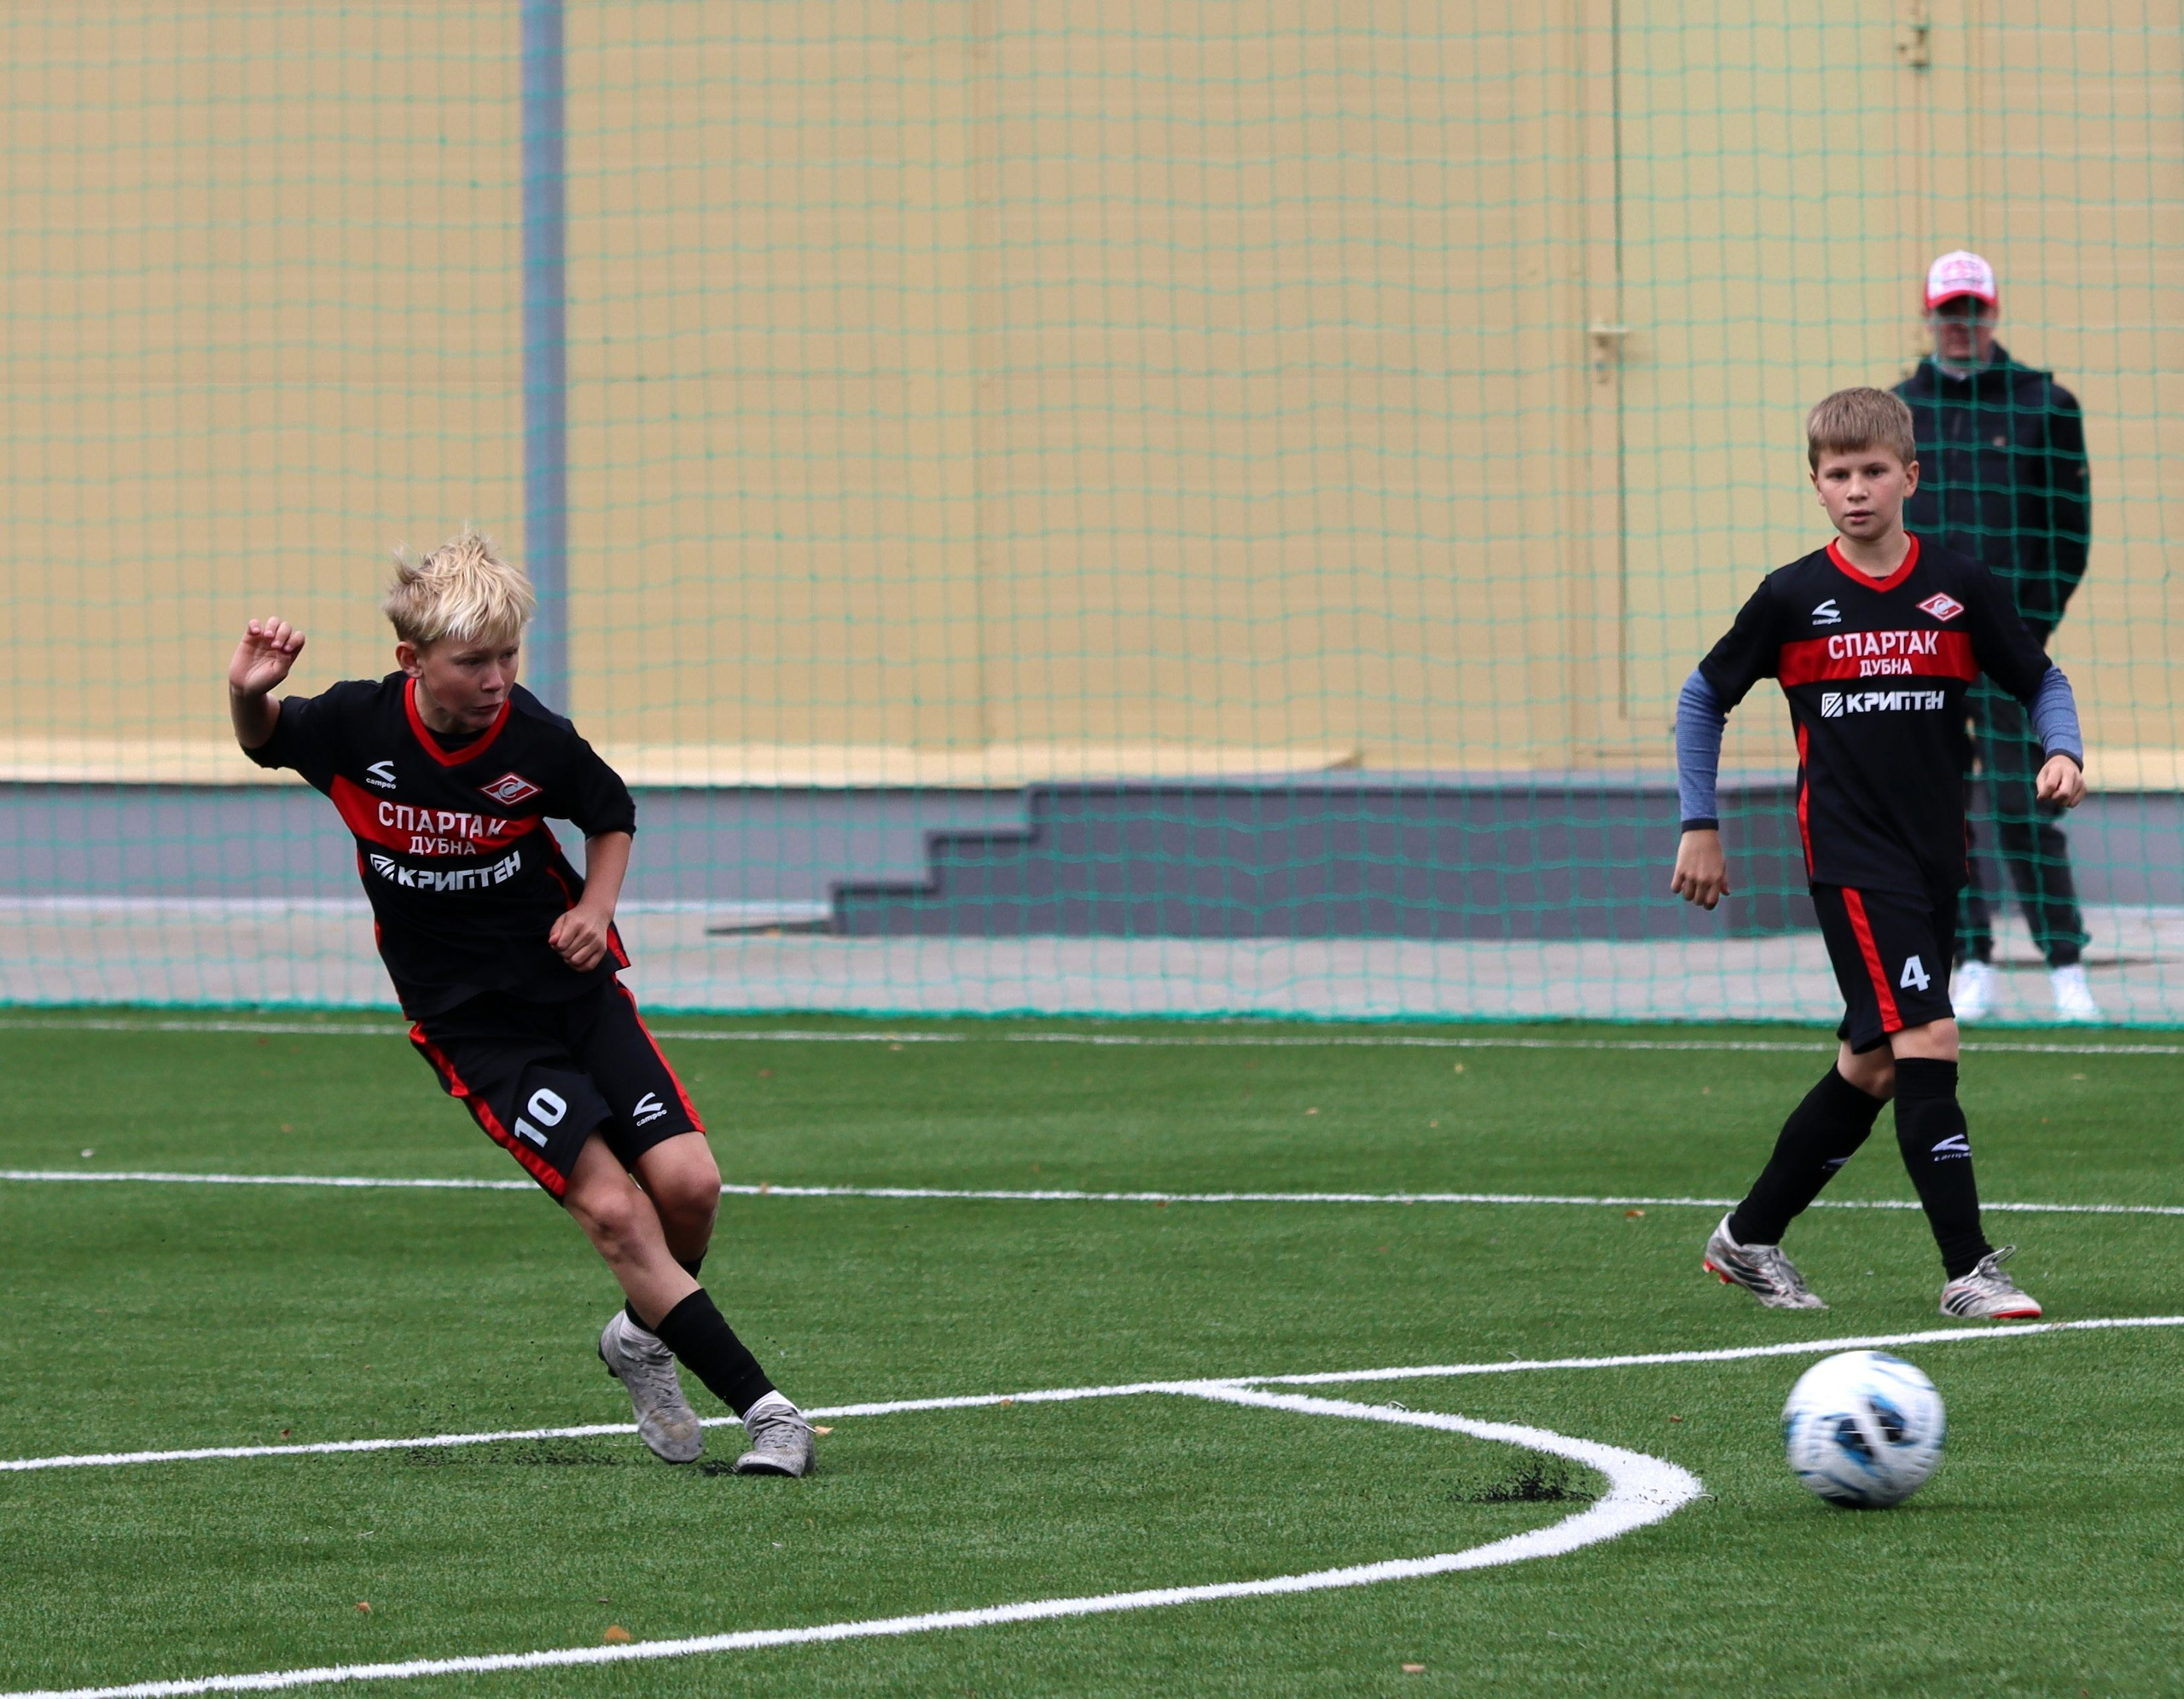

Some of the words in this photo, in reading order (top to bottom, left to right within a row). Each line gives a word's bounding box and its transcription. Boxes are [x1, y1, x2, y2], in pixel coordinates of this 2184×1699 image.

[1827, 630, 1939, 659] СПАРТАК
[1860, 658, 1913, 678] ДУБНА
[1846, 690, 1945, 714] КРИПТЕН
[378, 801, 508, 839] СПАРТАК
[409, 836, 477, 855] ДУБНА
[398, 850, 521, 892] КРИПТЕН
[1900, 954, 1931, 991] 4
[514, 1087, 567, 1148] 10
